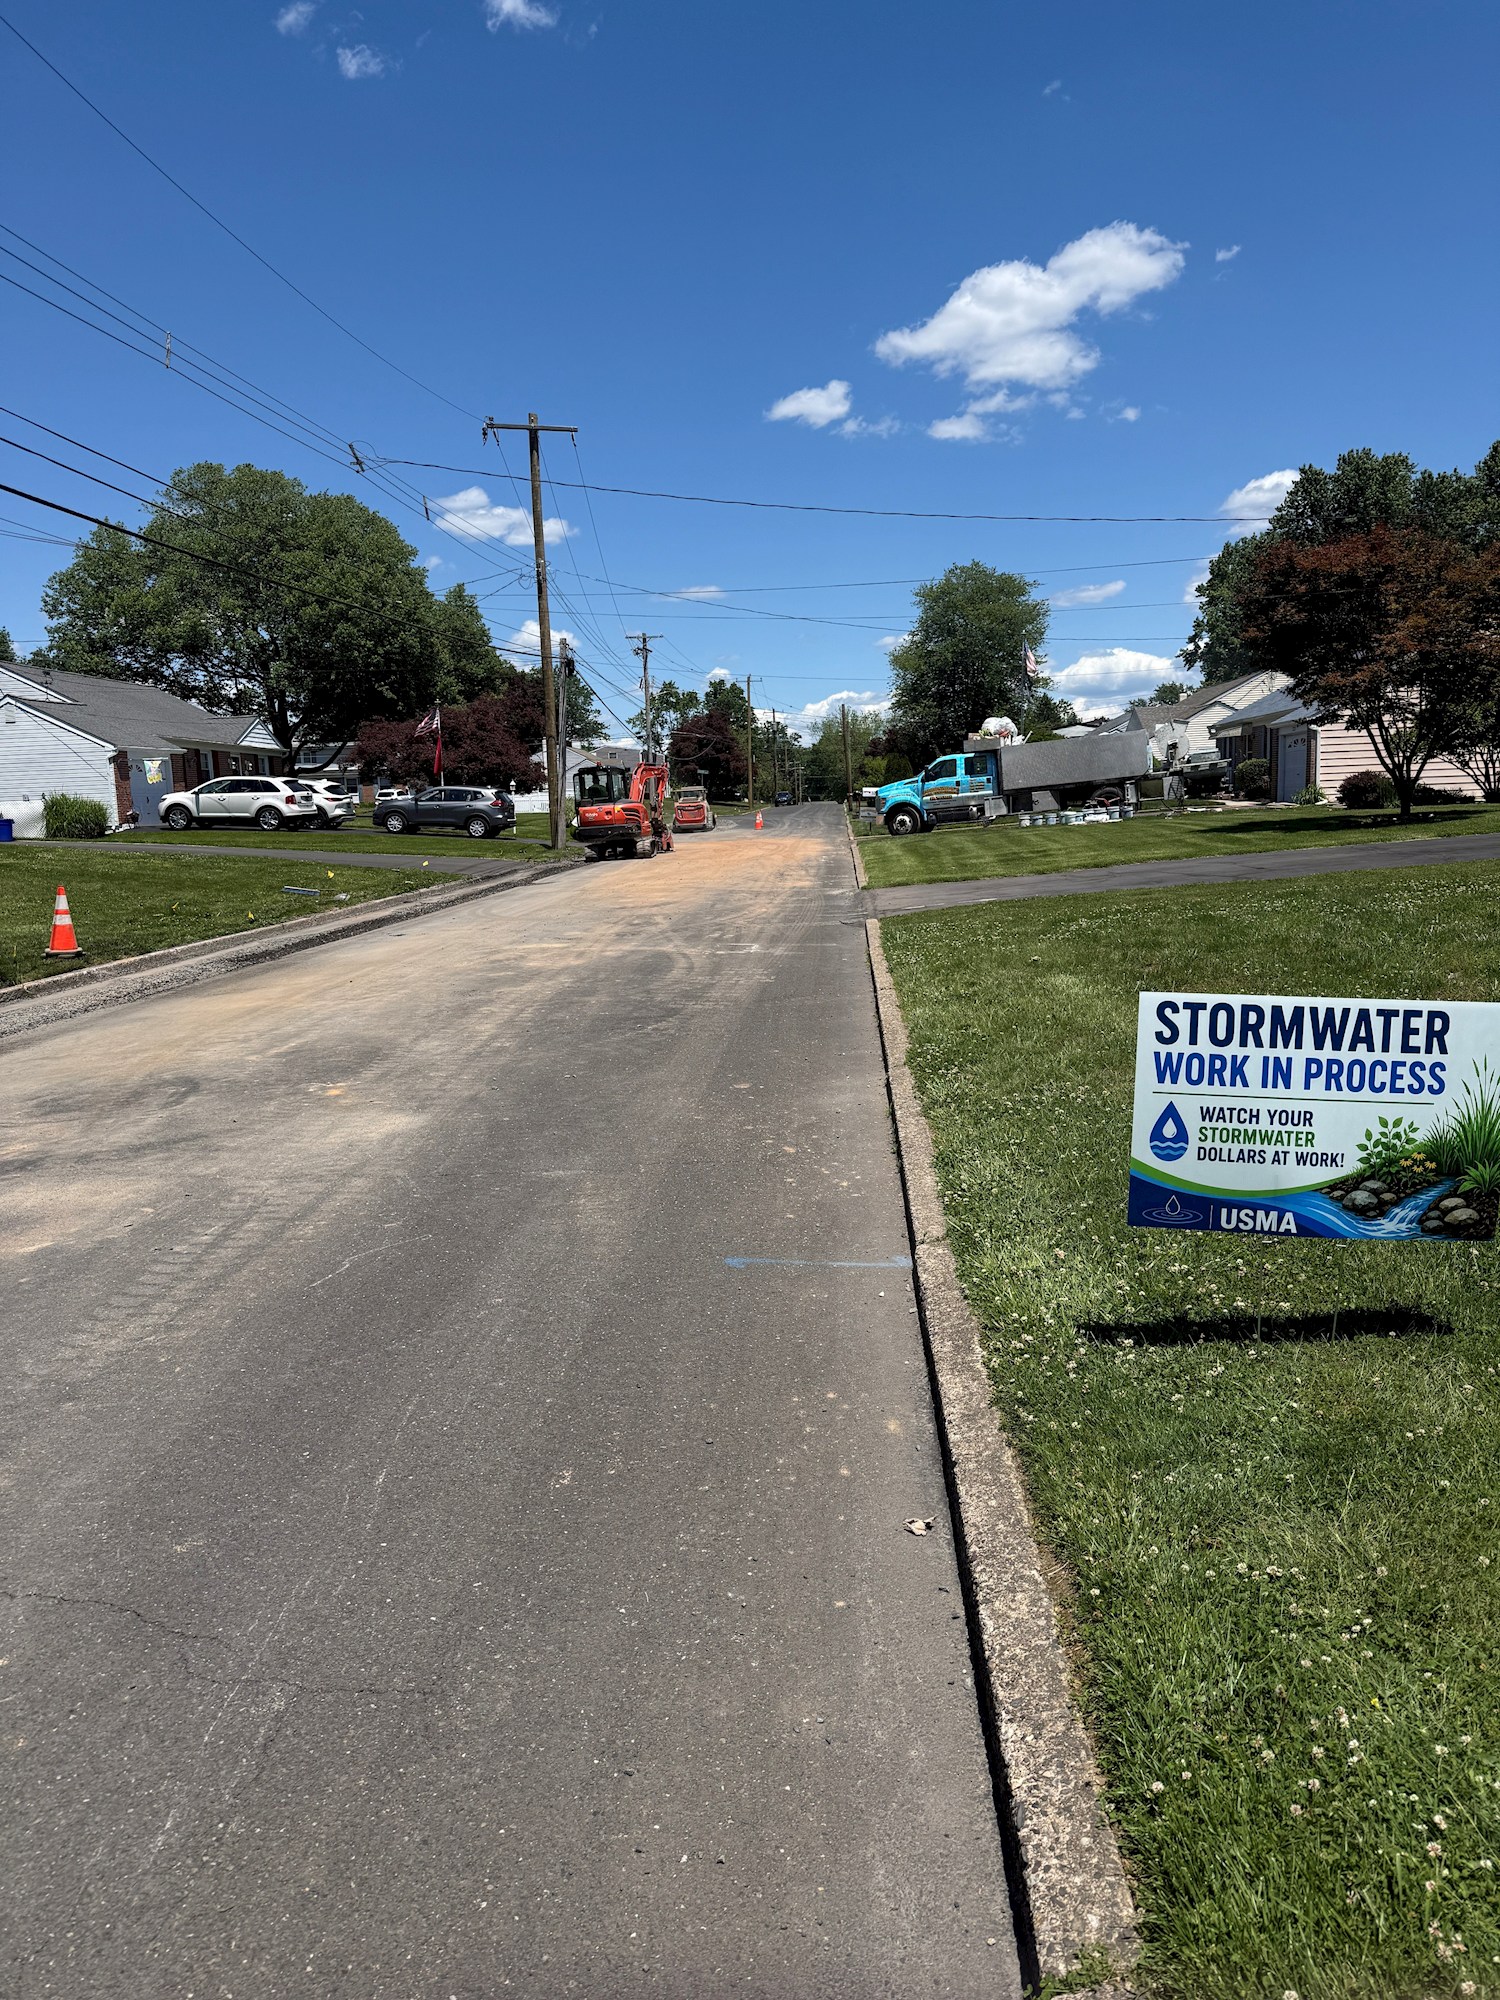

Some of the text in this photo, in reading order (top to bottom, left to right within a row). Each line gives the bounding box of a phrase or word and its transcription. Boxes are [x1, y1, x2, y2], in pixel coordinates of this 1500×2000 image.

[1154, 1000, 1451, 1055] STORMWATER
[1153, 1051, 1447, 1096] WORK IN PROCESS
[1199, 1106, 1314, 1128] WATCH YOUR
[1198, 1126, 1316, 1148] STORMWATER
[1197, 1147, 1345, 1168] DOLLARS AT WORK!
[1219, 1208, 1298, 1234] USMA
